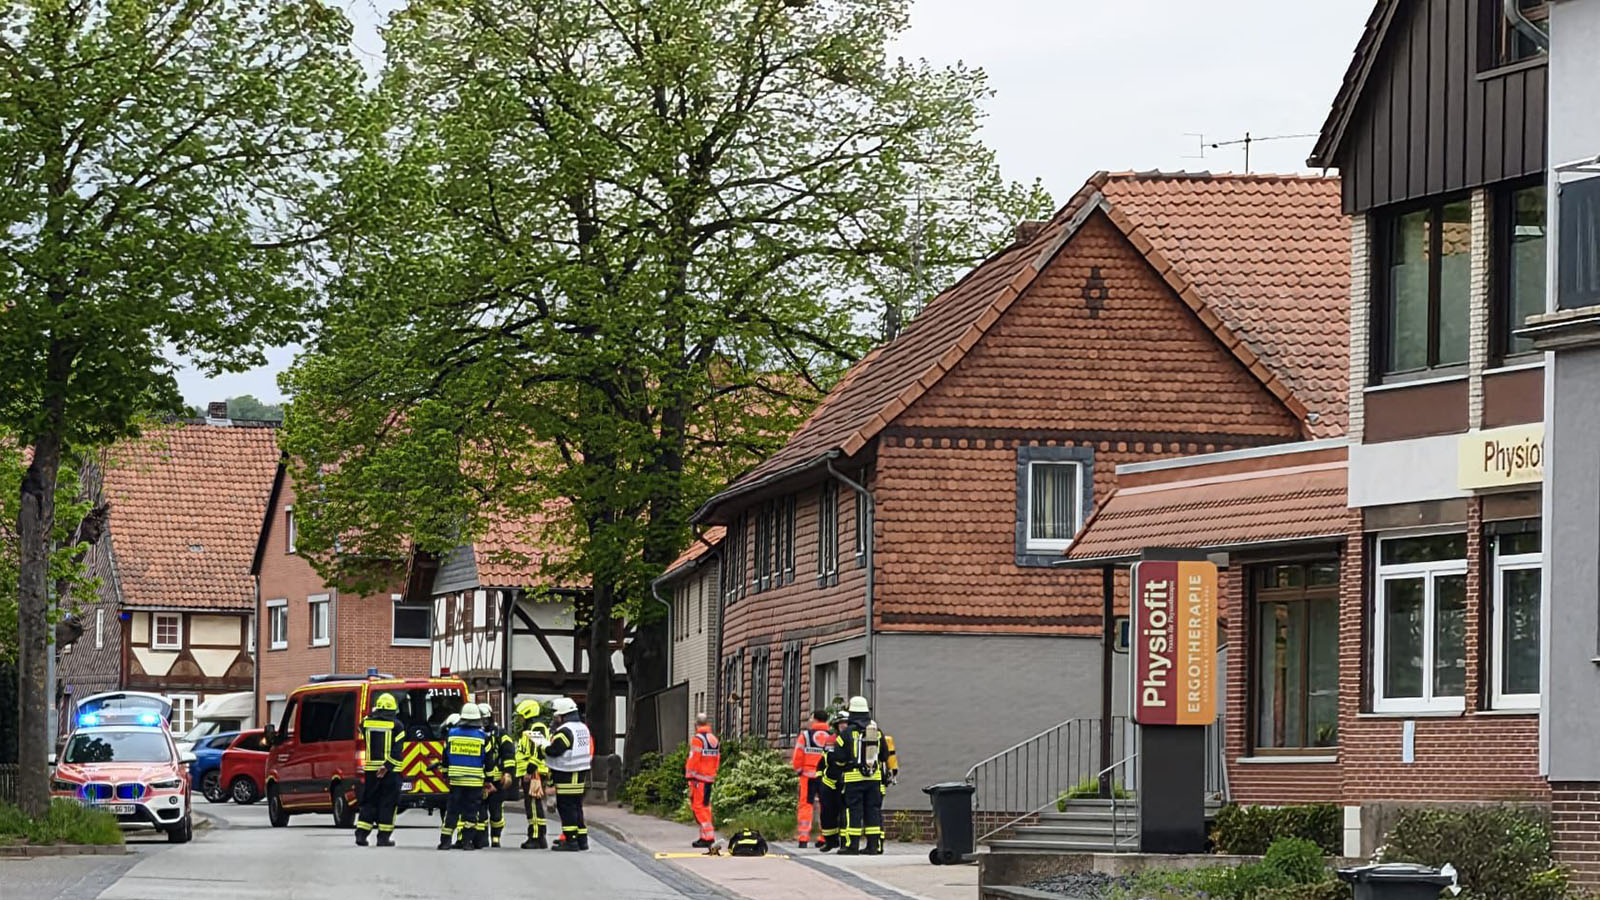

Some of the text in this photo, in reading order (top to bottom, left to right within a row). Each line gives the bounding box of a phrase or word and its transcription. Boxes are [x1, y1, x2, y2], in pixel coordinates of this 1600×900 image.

[428, 688, 461, 697] 21-11-1
[1143, 580, 1172, 707] Physiofit
[1188, 575, 1202, 712] ERGOTHERAPIE
